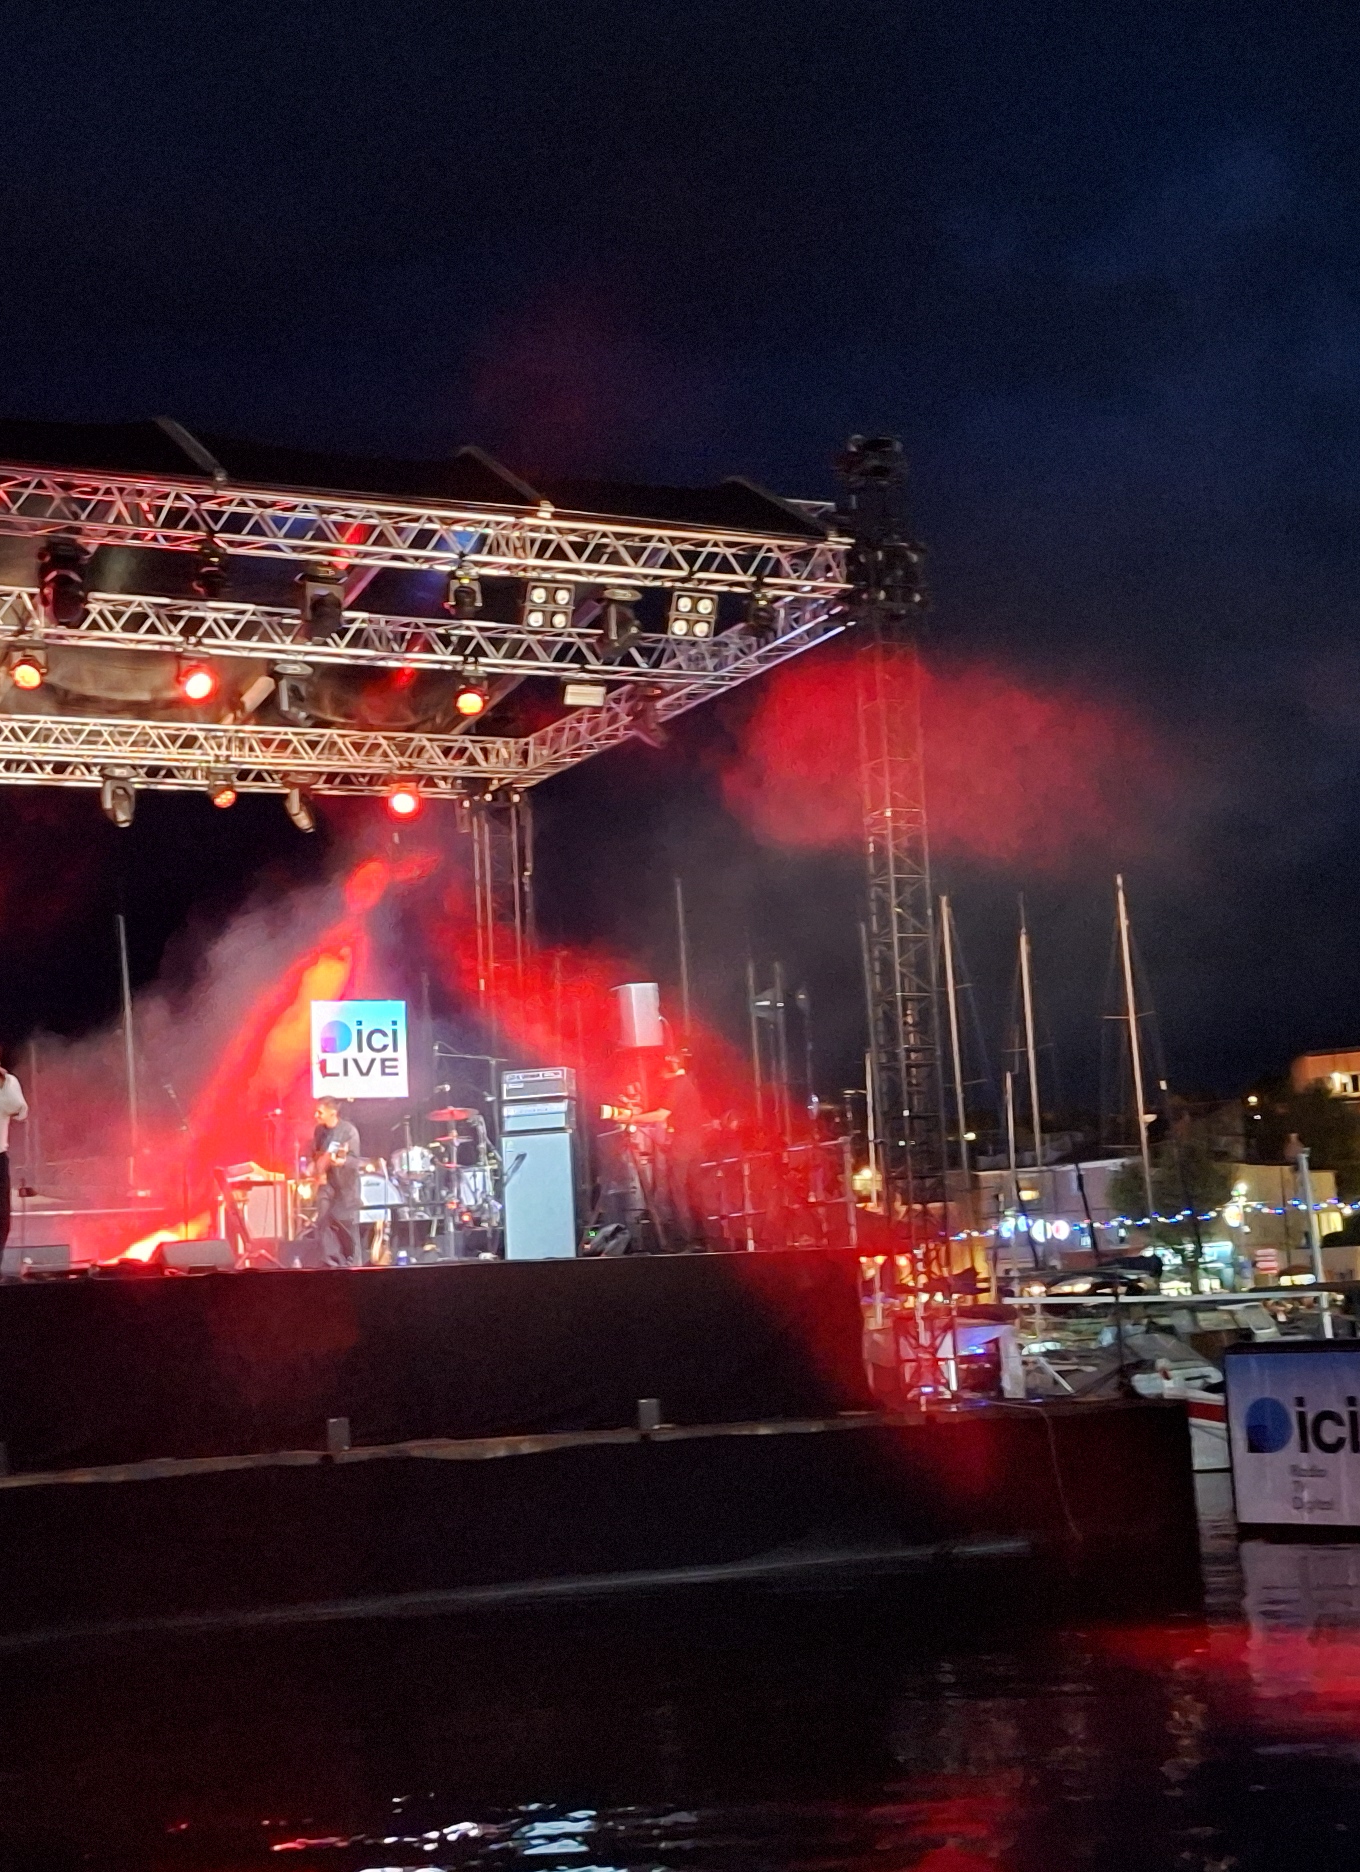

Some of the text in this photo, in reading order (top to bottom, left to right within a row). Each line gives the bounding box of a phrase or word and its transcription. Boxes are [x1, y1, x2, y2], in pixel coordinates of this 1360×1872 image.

[356, 1020, 399, 1054] ici
[319, 1057, 400, 1077] LIVE
[1294, 1395, 1360, 1454] ici
